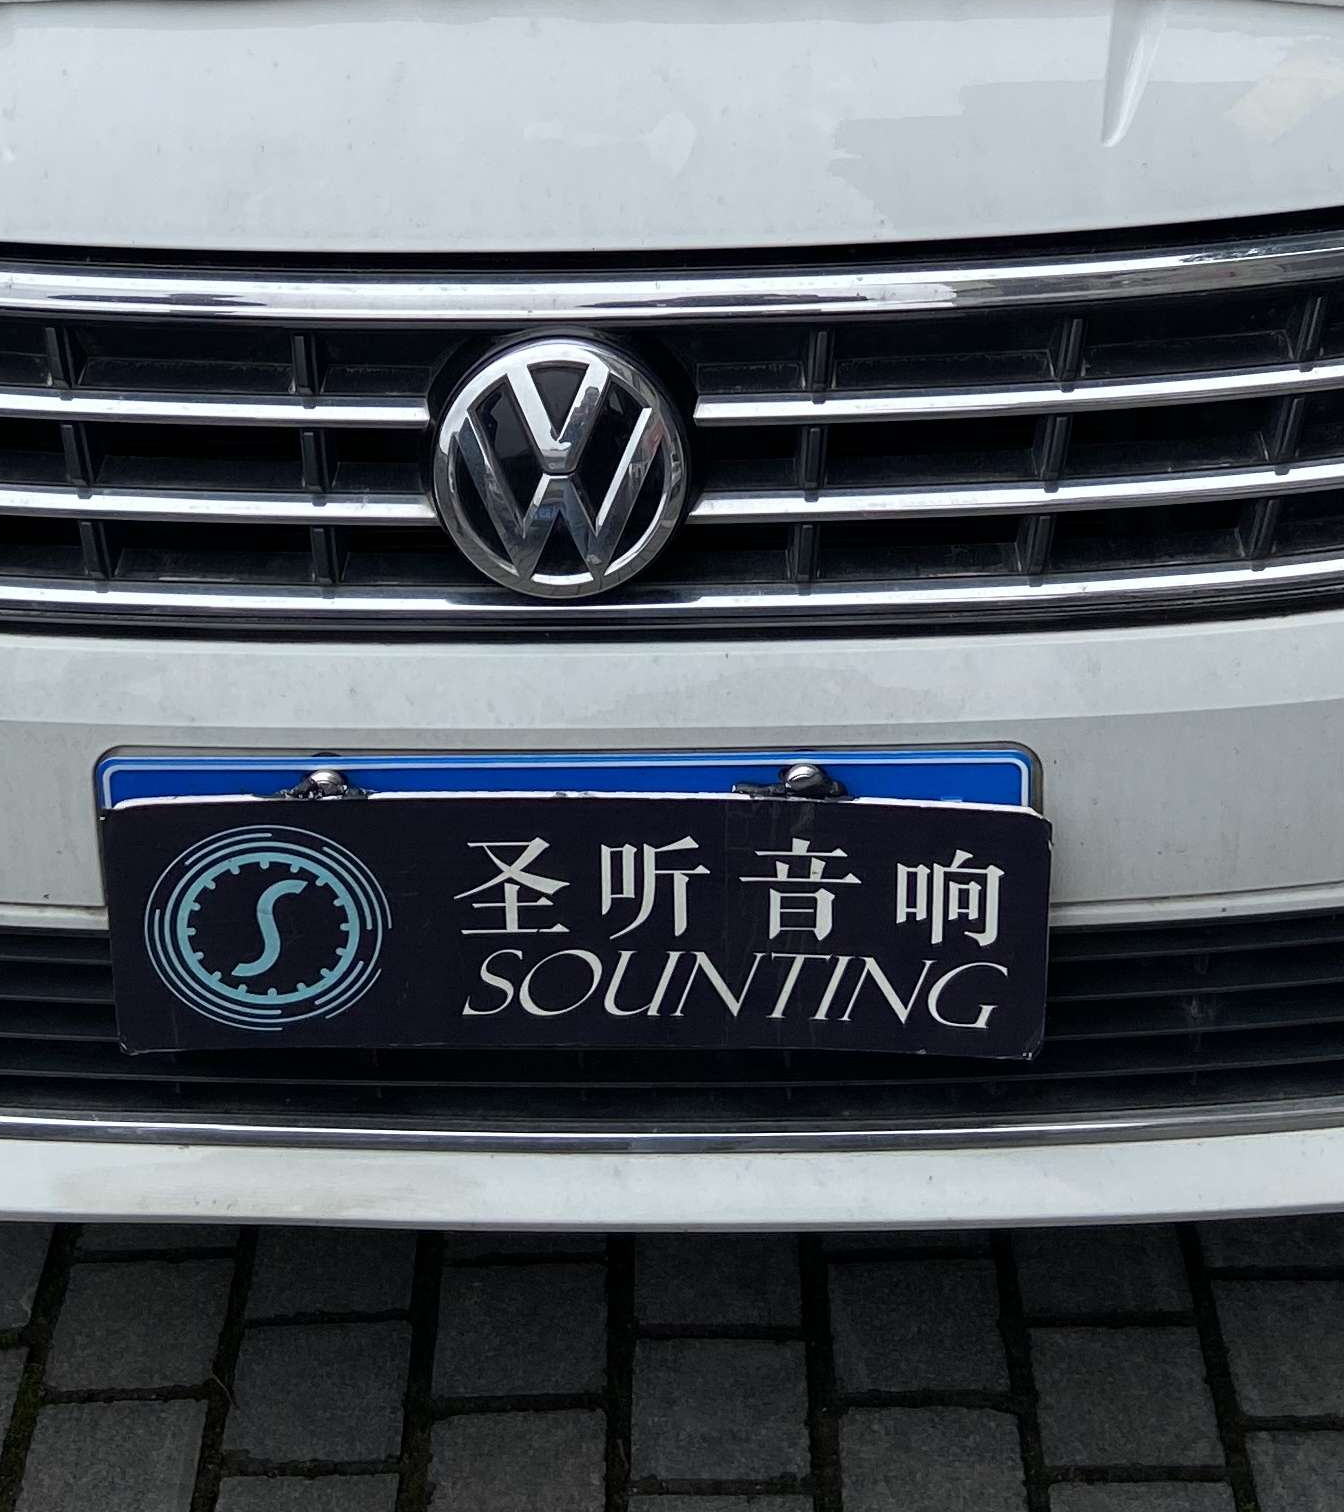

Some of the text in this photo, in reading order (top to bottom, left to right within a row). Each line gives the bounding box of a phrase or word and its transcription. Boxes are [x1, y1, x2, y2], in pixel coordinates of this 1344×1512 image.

[453, 835, 1006, 947] 圣听音响
[461, 948, 1010, 1030] SOUNTING
